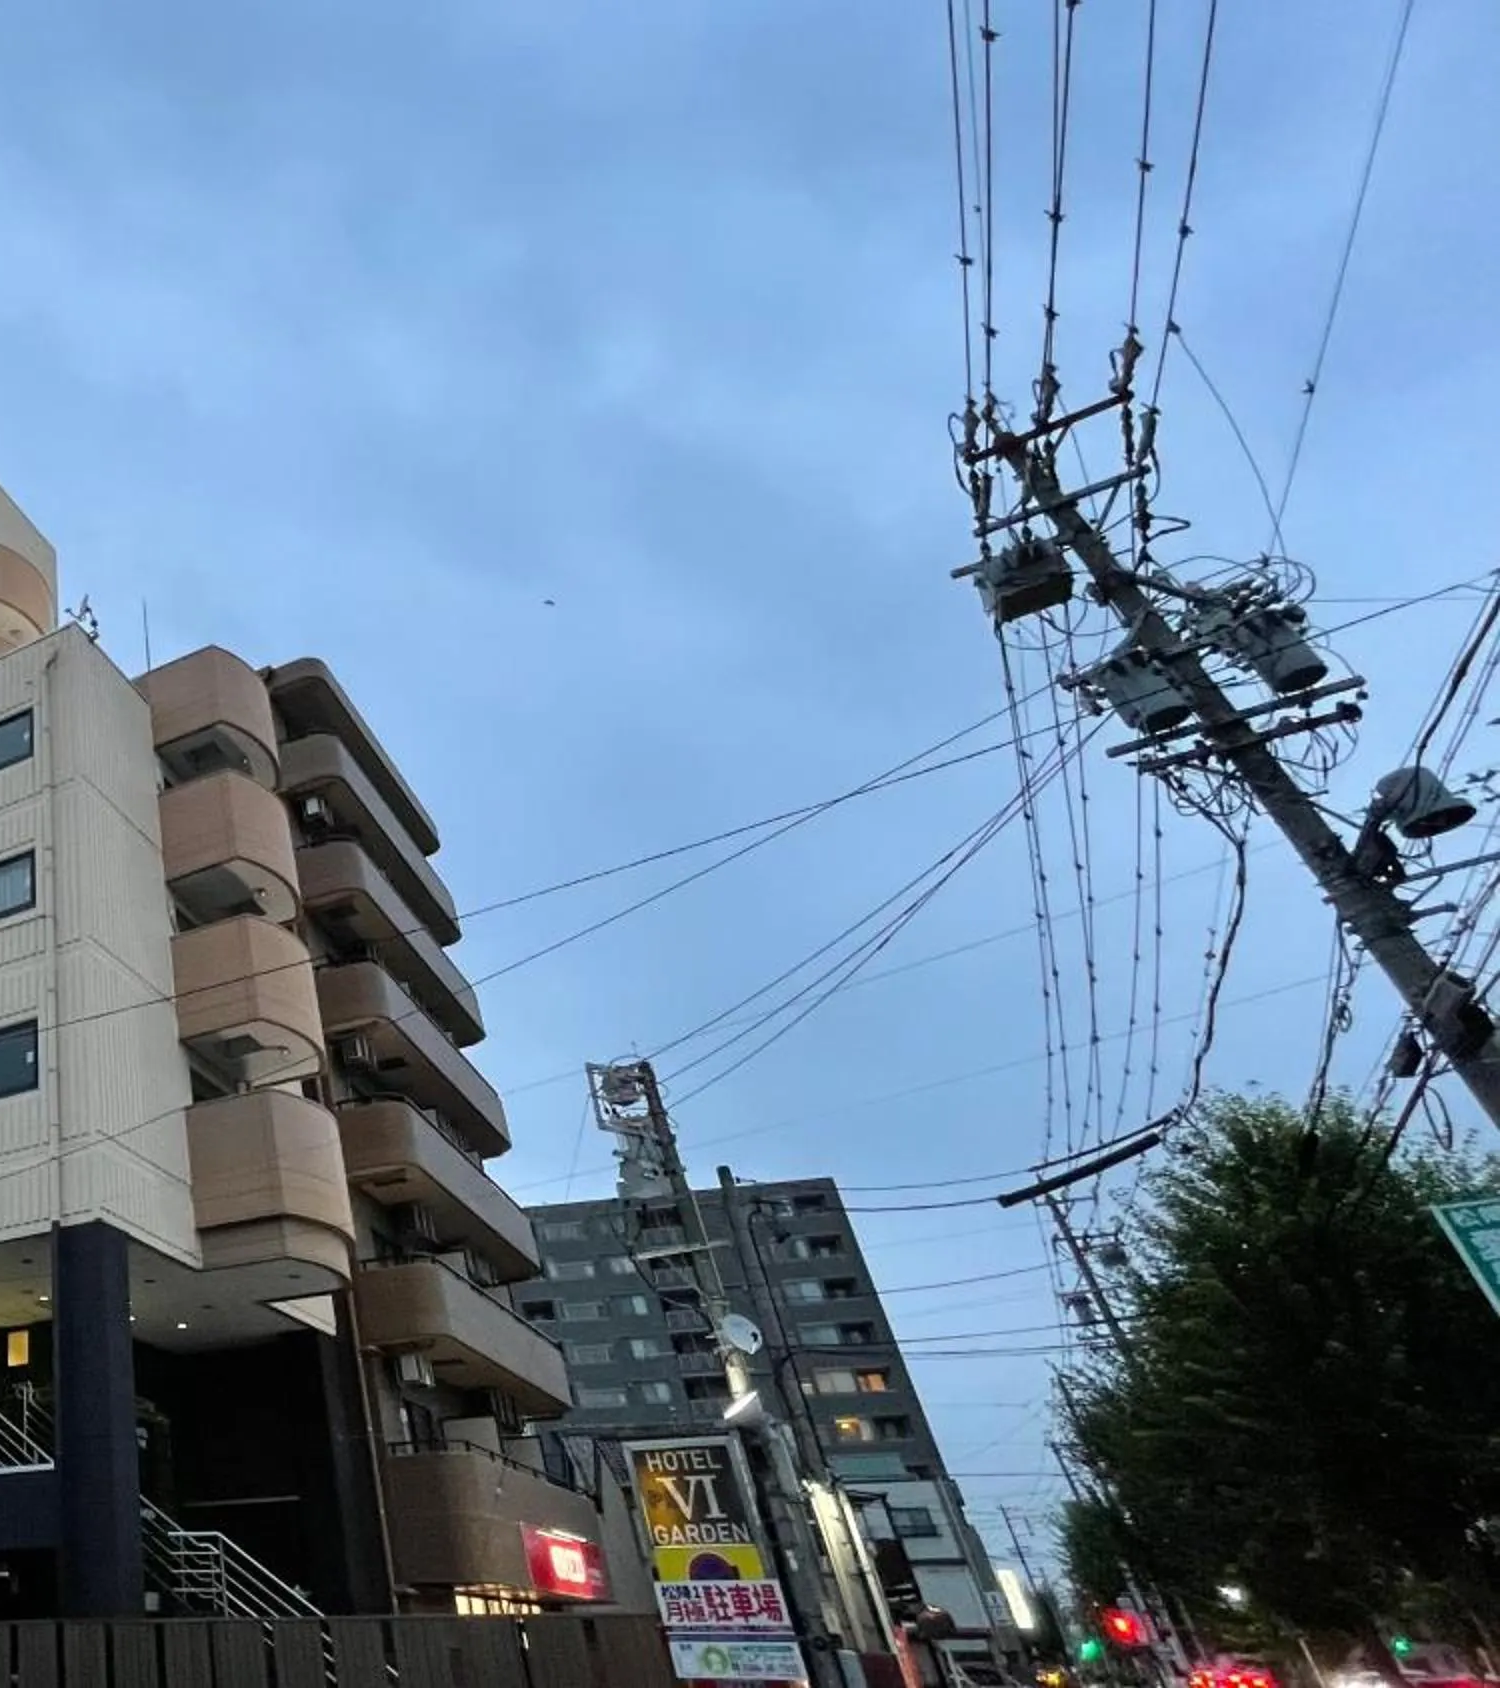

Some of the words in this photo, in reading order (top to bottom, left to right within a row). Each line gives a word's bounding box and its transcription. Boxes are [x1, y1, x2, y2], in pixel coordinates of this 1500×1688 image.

[647, 1451, 722, 1472] HOTEL
[655, 1475, 727, 1520] VI
[654, 1523, 749, 1545] GARDEN
